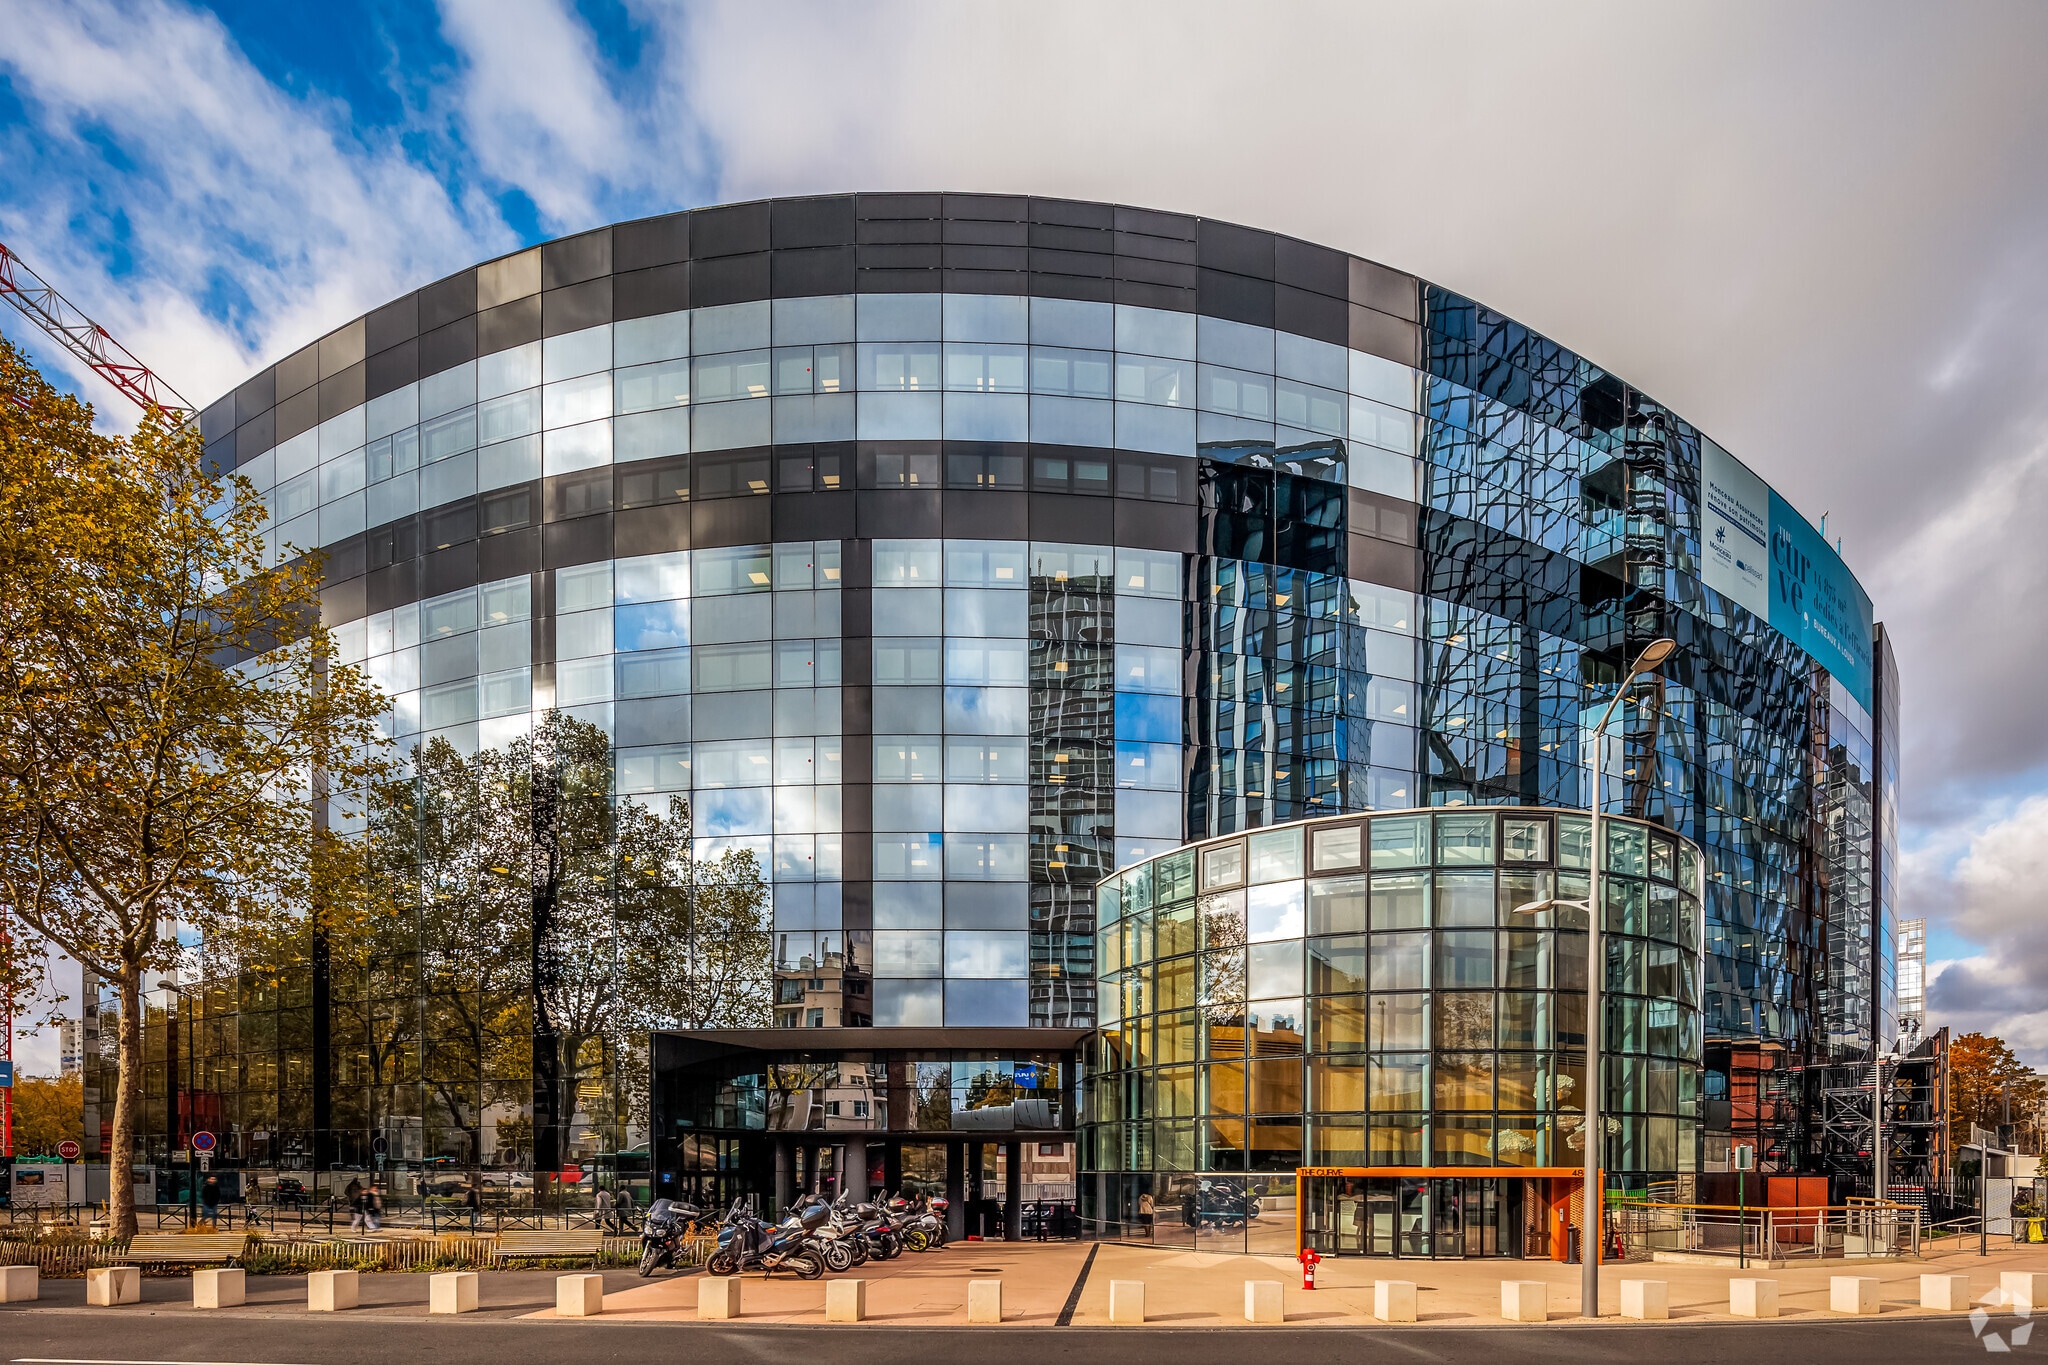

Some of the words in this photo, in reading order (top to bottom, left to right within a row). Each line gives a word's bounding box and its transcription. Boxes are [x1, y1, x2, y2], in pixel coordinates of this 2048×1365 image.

[1707, 491, 1727, 510] rénove
[1728, 506, 1738, 518] son
[1739, 514, 1766, 538] patrimoine
[1709, 480, 1735, 504] Monceau
[1735, 500, 1764, 526] Assurances
[1813, 618, 1837, 646] BUREAUX
[1841, 645, 1855, 667] LOUER
[1300, 1168, 1315, 1177] THE
[1316, 1168, 1344, 1177] CURVE
